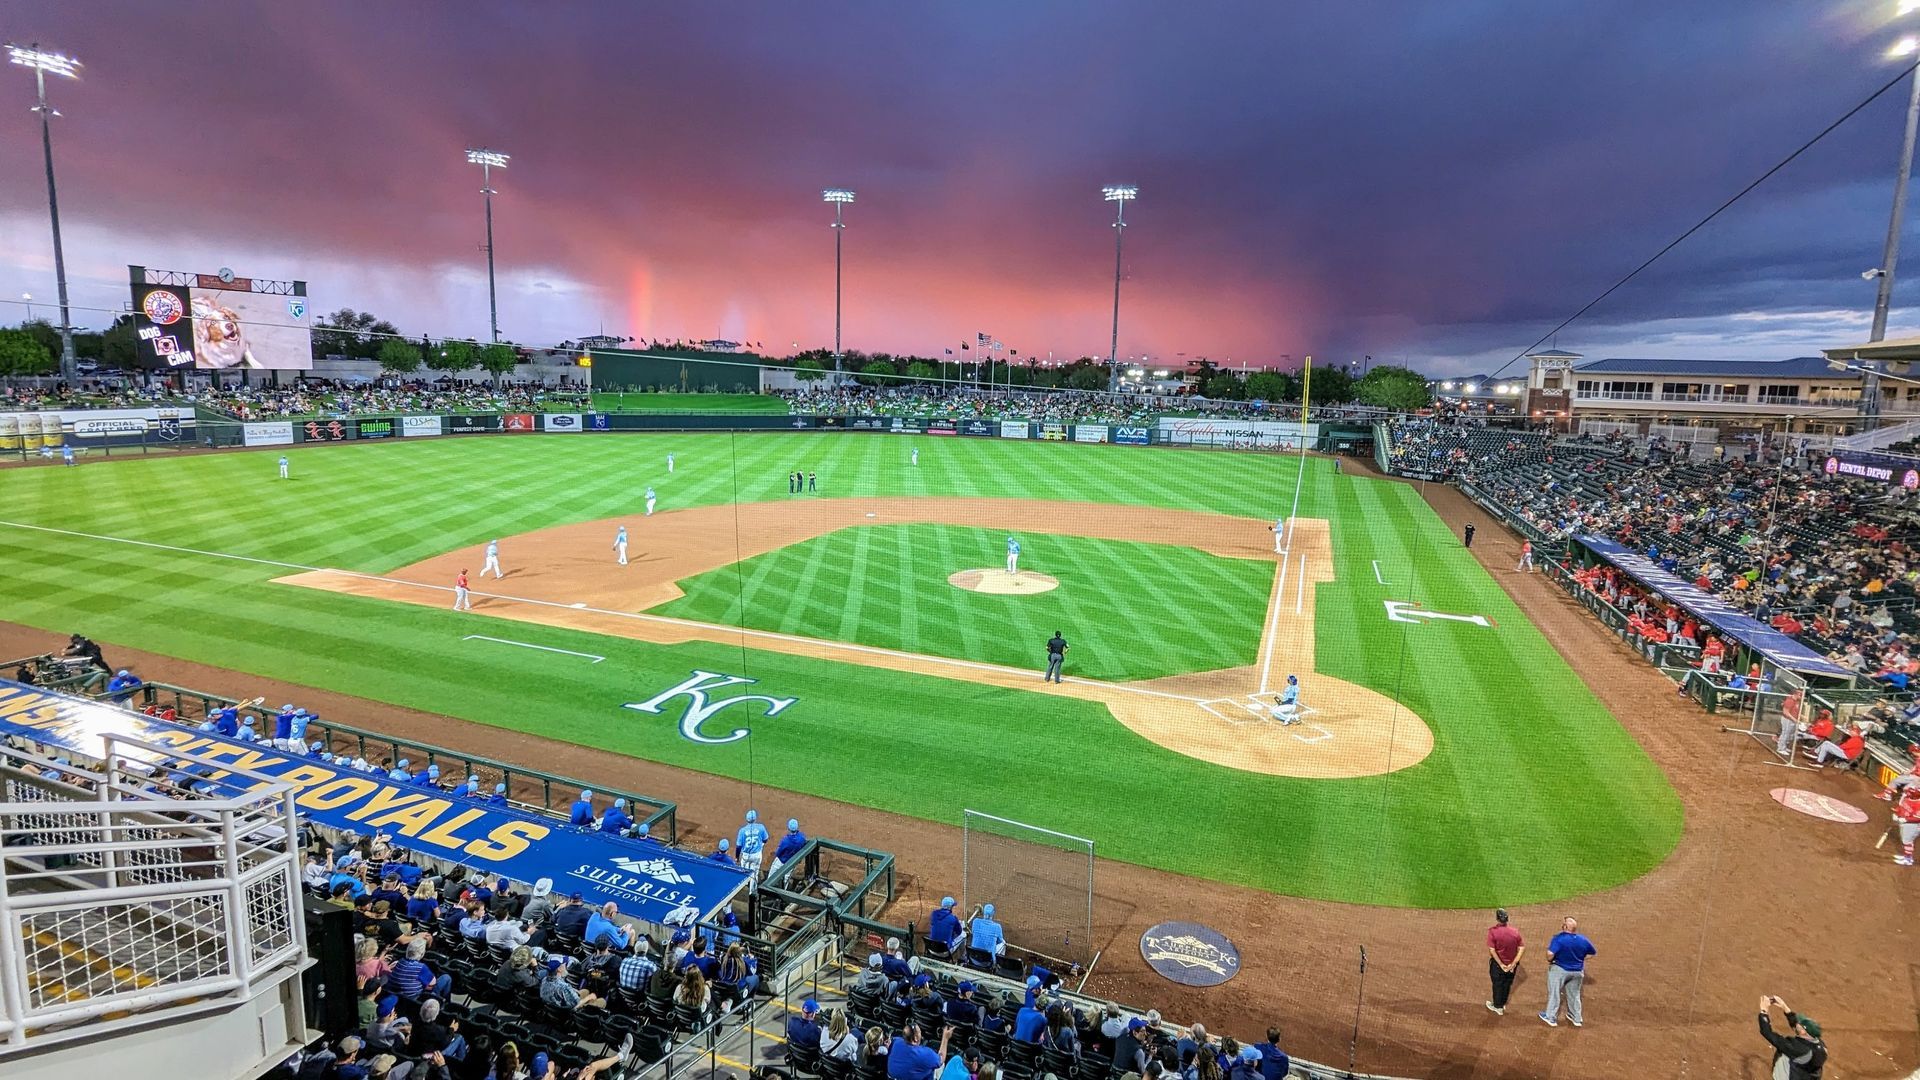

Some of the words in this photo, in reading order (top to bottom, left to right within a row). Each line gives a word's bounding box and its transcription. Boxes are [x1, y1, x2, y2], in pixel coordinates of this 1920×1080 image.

[139, 326, 160, 340] DOG
[167, 351, 194, 367] CAM
[1117, 427, 1147, 436] AVR
[1225, 429, 1264, 438] NISSAN
[1839, 462, 1866, 476] DENTAL
[1866, 467, 1893, 480] DEPOT
[622, 669, 799, 743] KC
[248, 764, 551, 862] ROYALS
[745, 836, 759, 848] 25
[573, 864, 697, 907] SURPRISE
[592, 885, 648, 905] ARIZONA
[1219, 952, 1237, 967] KC
